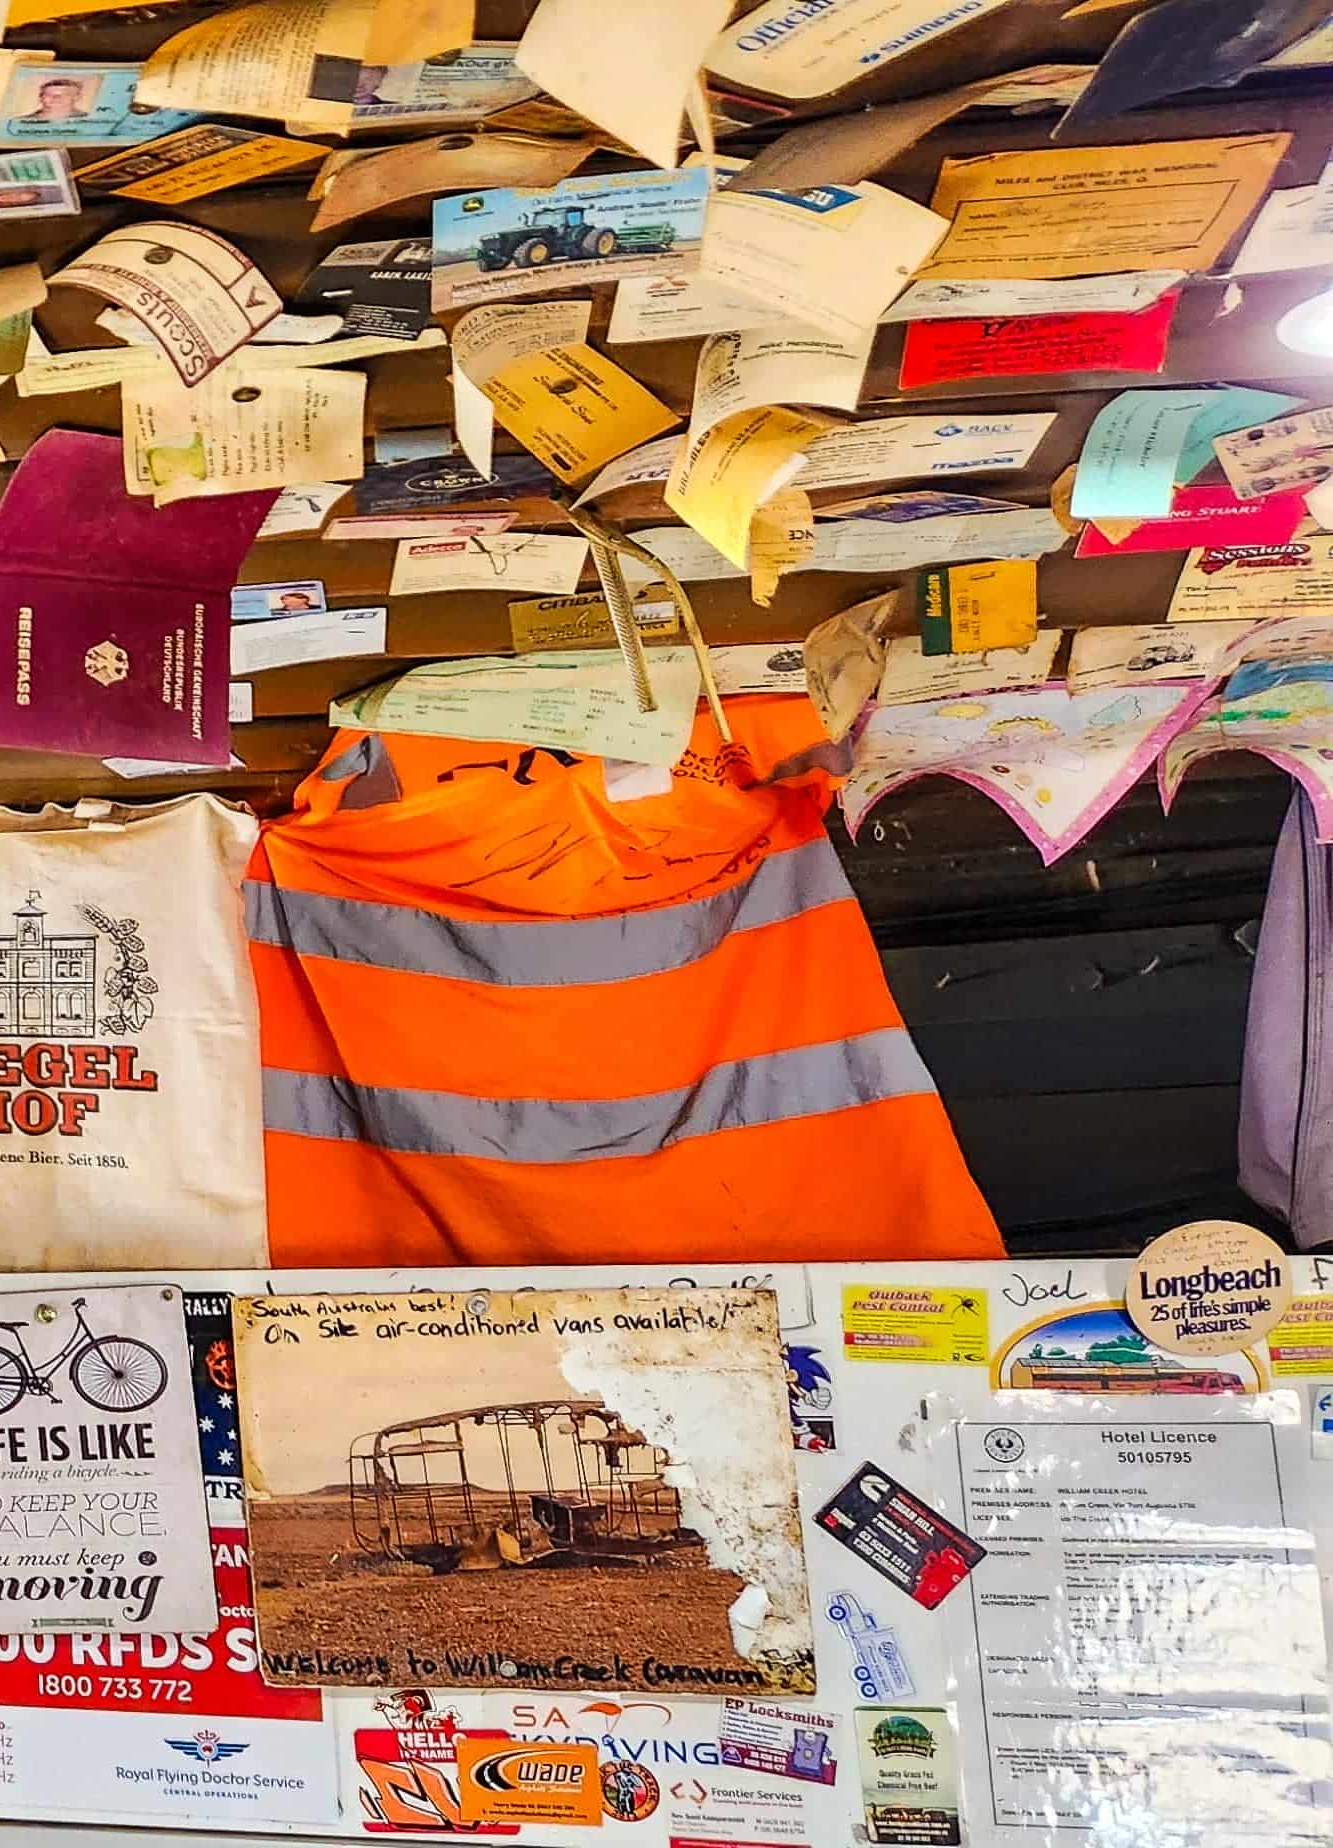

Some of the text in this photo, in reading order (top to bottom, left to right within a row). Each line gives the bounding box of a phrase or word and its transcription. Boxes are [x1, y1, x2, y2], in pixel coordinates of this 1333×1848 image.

[16, 606, 33, 706] REISEPASS
[27, 1149, 66, 1167] Bier.
[67, 1152, 93, 1169] Seit
[95, 1153, 131, 1171] 1850.
[1001, 1269, 1088, 1308] Joel
[1139, 1258, 1282, 1302] Longbeach
[251, 1298, 311, 1319] South
[407, 1294, 456, 1313] best!
[851, 1300, 947, 1314] Pest Control
[868, 1289, 934, 1302] Outback
[1150, 1294, 1273, 1323] 25 of life's simple
[263, 1323, 302, 1345] On
[375, 1310, 540, 1344] air-conditioned
[552, 1314, 605, 1336] vans
[1175, 1316, 1252, 1341] pleasures.
[37, 1425, 72, 1462] IS
[78, 1421, 156, 1462] LIKE
[1100, 1430, 1218, 1446] Hotel Licence
[1116, 1450, 1193, 1465] 50105795
[0, 1463, 49, 1484] riding
[52, 1467, 63, 1479] a
[8, 1493, 78, 1514] KEEP
[82, 1490, 159, 1513] YOUR
[16, 1550, 71, 1568] must
[75, 1547, 126, 1572] keep
[72, 1632, 215, 1672] RFDS
[37, 1673, 194, 1702] 1800 733 772
[512, 1705, 571, 1730] SA
[724, 1697, 835, 1730] EP Locksmiths
[420, 1749, 455, 1761] NAME
[115, 1765, 306, 1790] Royal Flying Doctor Service
[163, 1787, 259, 1801] CENTRAL OPERATIONS
[711, 1786, 803, 1802] Frontier Services
